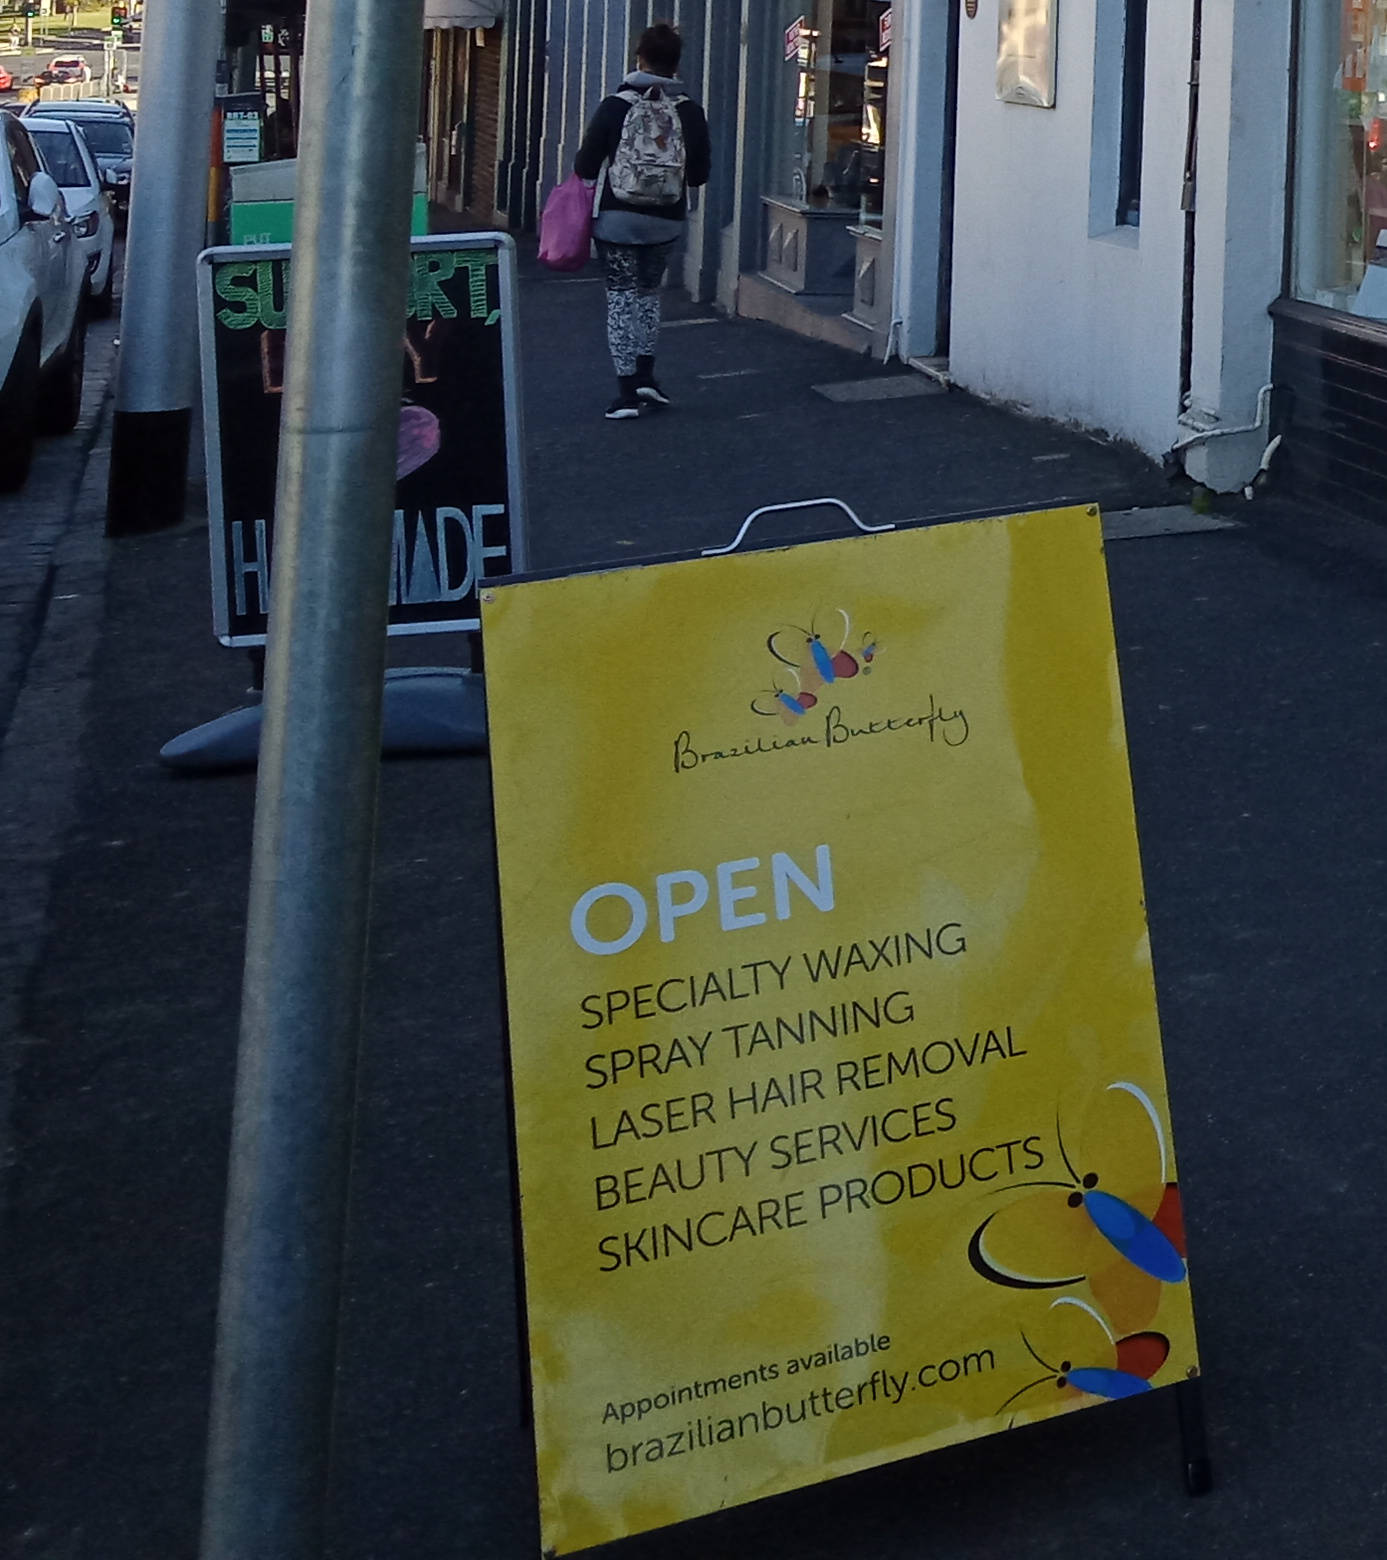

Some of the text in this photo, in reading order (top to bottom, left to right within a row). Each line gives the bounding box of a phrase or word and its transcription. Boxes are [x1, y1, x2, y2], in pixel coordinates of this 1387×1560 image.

[672, 694, 971, 775] Brazilian Butterfly
[570, 843, 835, 957] OPEN
[580, 922, 968, 1030] SPECIALTY WAXING
[584, 992, 917, 1090] SPRAY TANNING
[591, 1025, 1027, 1151] LASER HAIR REMOVAL
[594, 1098, 957, 1212] BEAUTY SERVICES
[597, 1135, 1044, 1274] SKINCARE PRODUCTS
[601, 1330, 892, 1426] Appointments available
[605, 1343, 996, 1475] brazilianbutterfly.com
